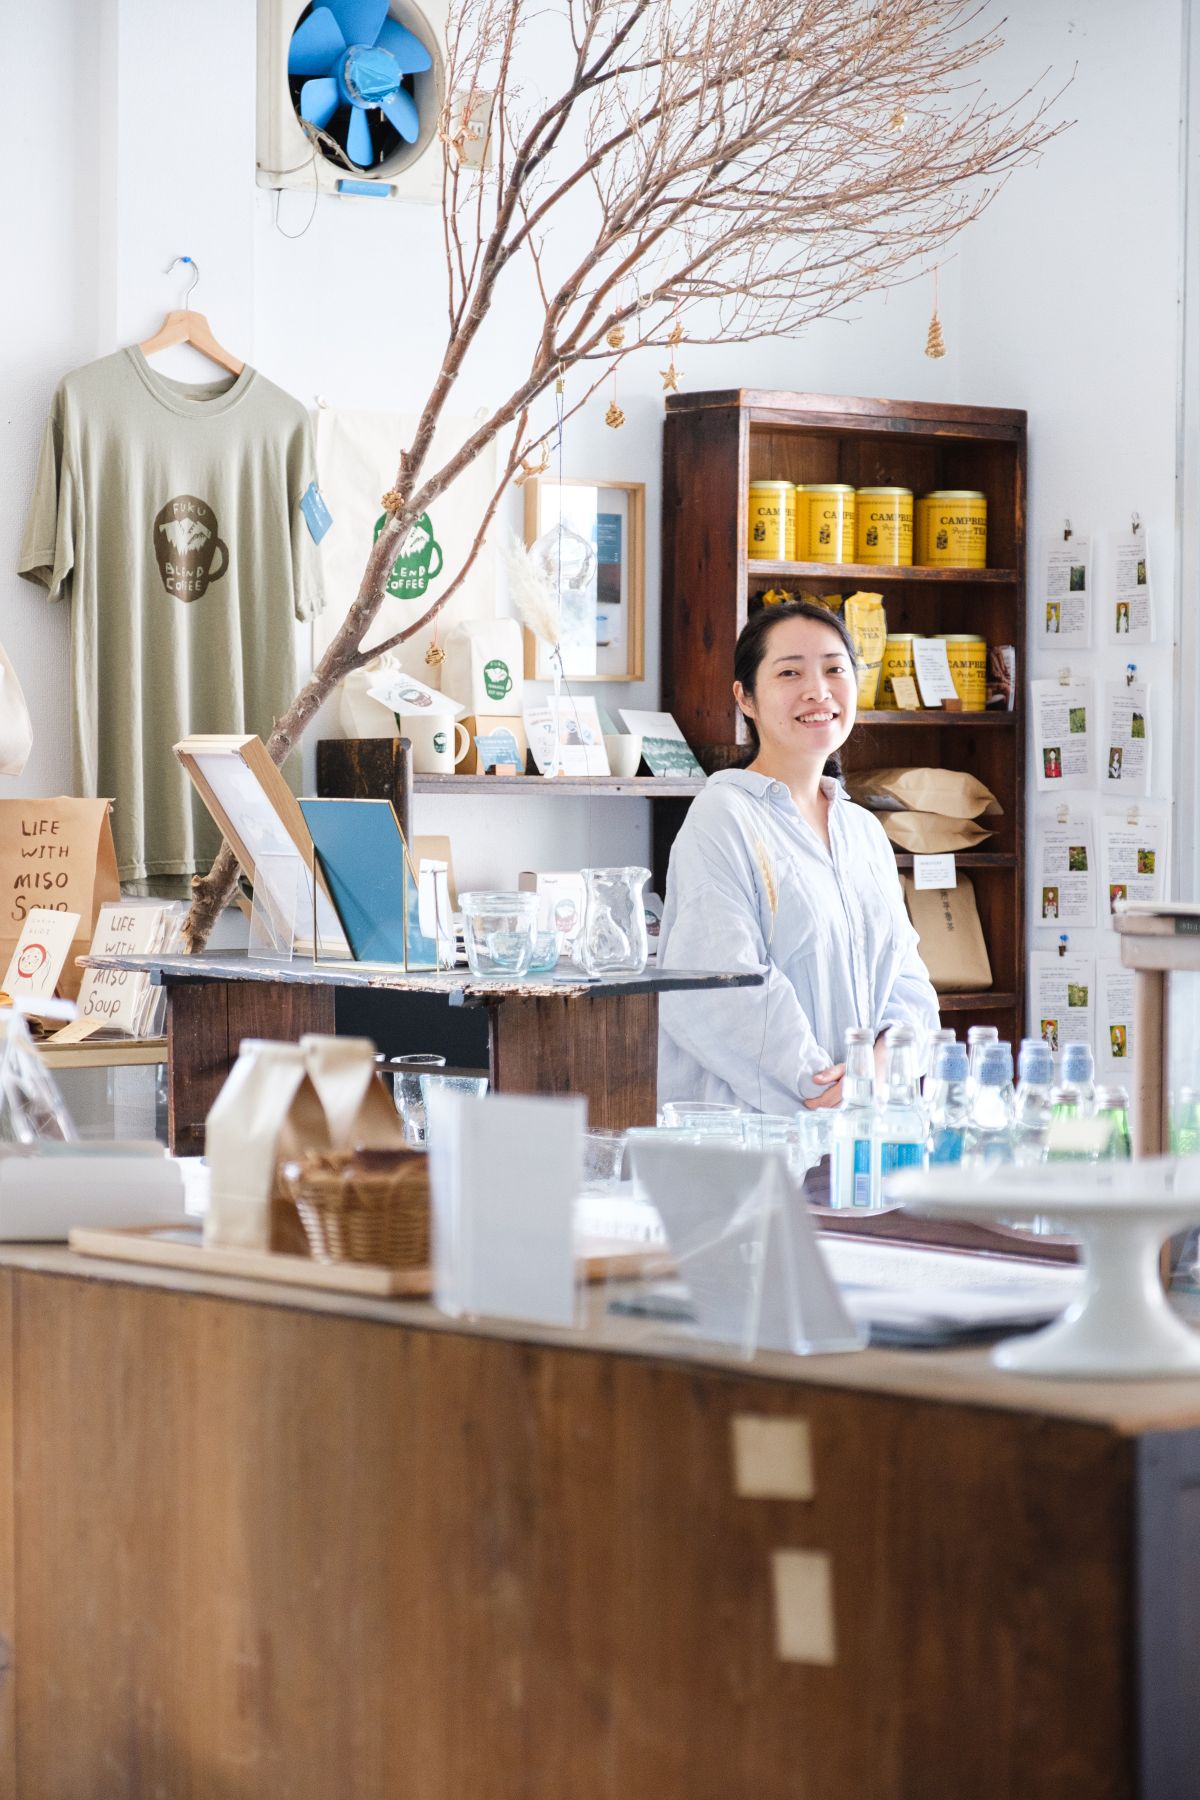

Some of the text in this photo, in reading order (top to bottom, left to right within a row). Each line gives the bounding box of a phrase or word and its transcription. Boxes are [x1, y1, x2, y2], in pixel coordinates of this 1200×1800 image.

[173, 502, 206, 516] FUKU
[165, 562, 204, 578] BLEND
[391, 565, 426, 577] LEND
[166, 578, 202, 591] COFFEE
[387, 578, 425, 590] OFFEE
[21, 820, 60, 837] LIFE
[21, 844, 69, 859] WITH
[13, 871, 69, 890] MISO
[110, 915, 136, 932] LIFE
[105, 941, 136, 955] WITH
[92, 969, 128, 987] MISO
[83, 990, 121, 1018] Soup
